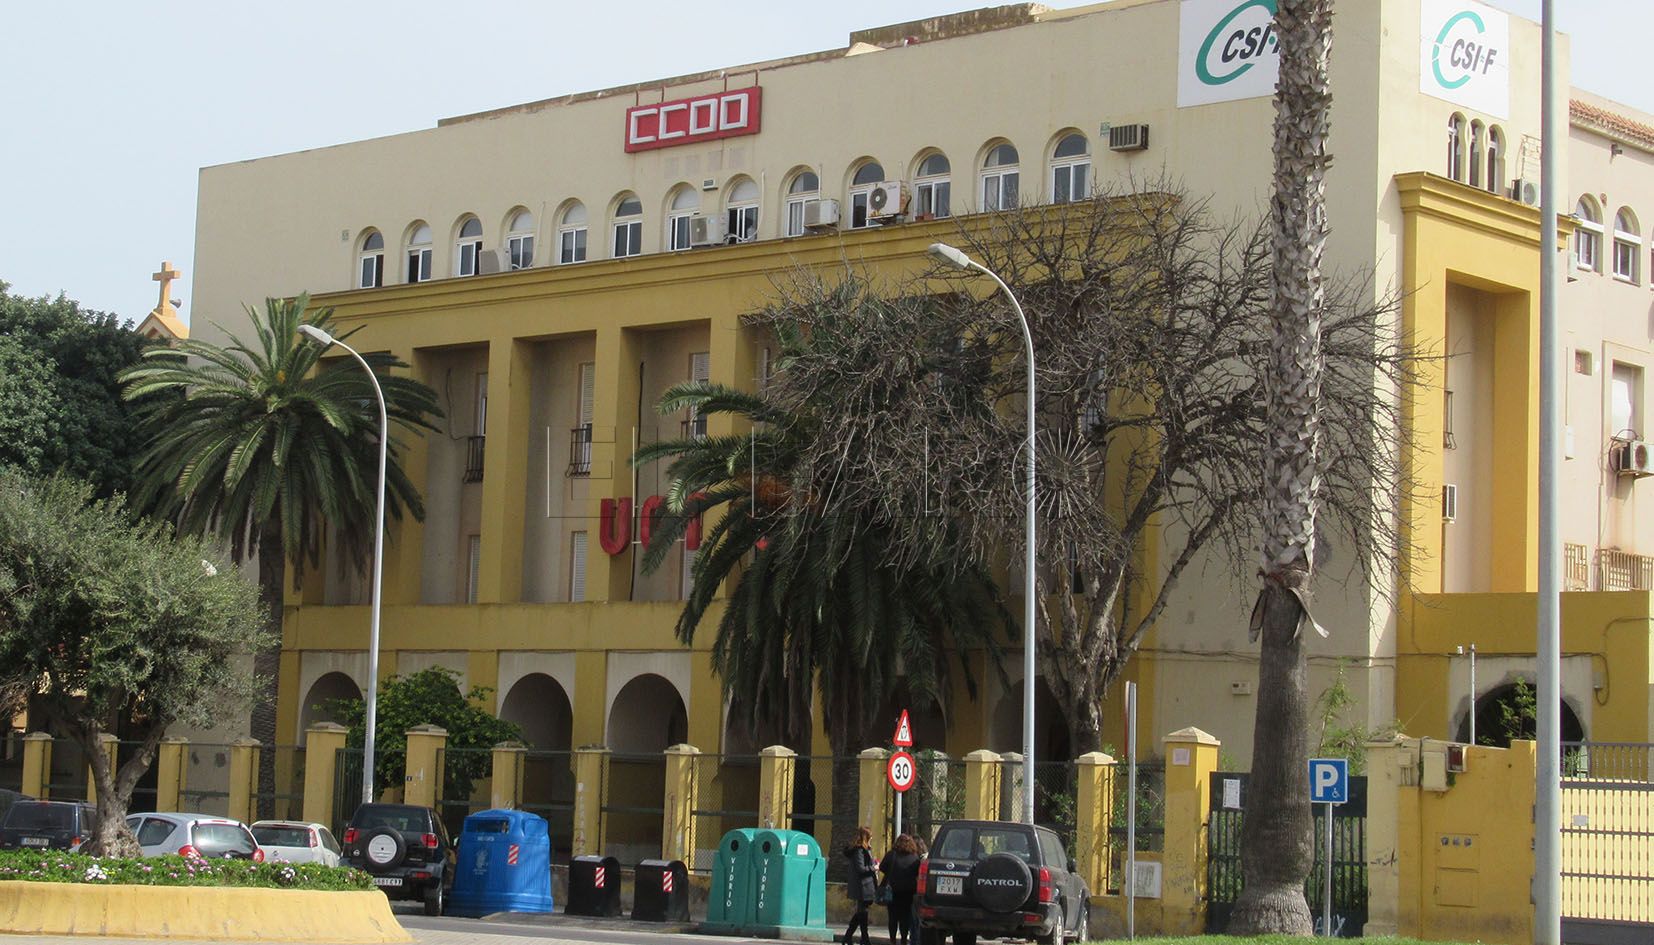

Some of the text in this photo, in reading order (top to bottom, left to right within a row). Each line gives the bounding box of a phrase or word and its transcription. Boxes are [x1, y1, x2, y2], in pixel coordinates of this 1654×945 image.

[630, 93, 748, 144] CCOO
[895, 763, 909, 780] 30
[1315, 764, 1338, 797] P
[726, 857, 736, 907] VIDRIO
[758, 858, 769, 909] VIDRIO
[977, 878, 1023, 887] PATROL
